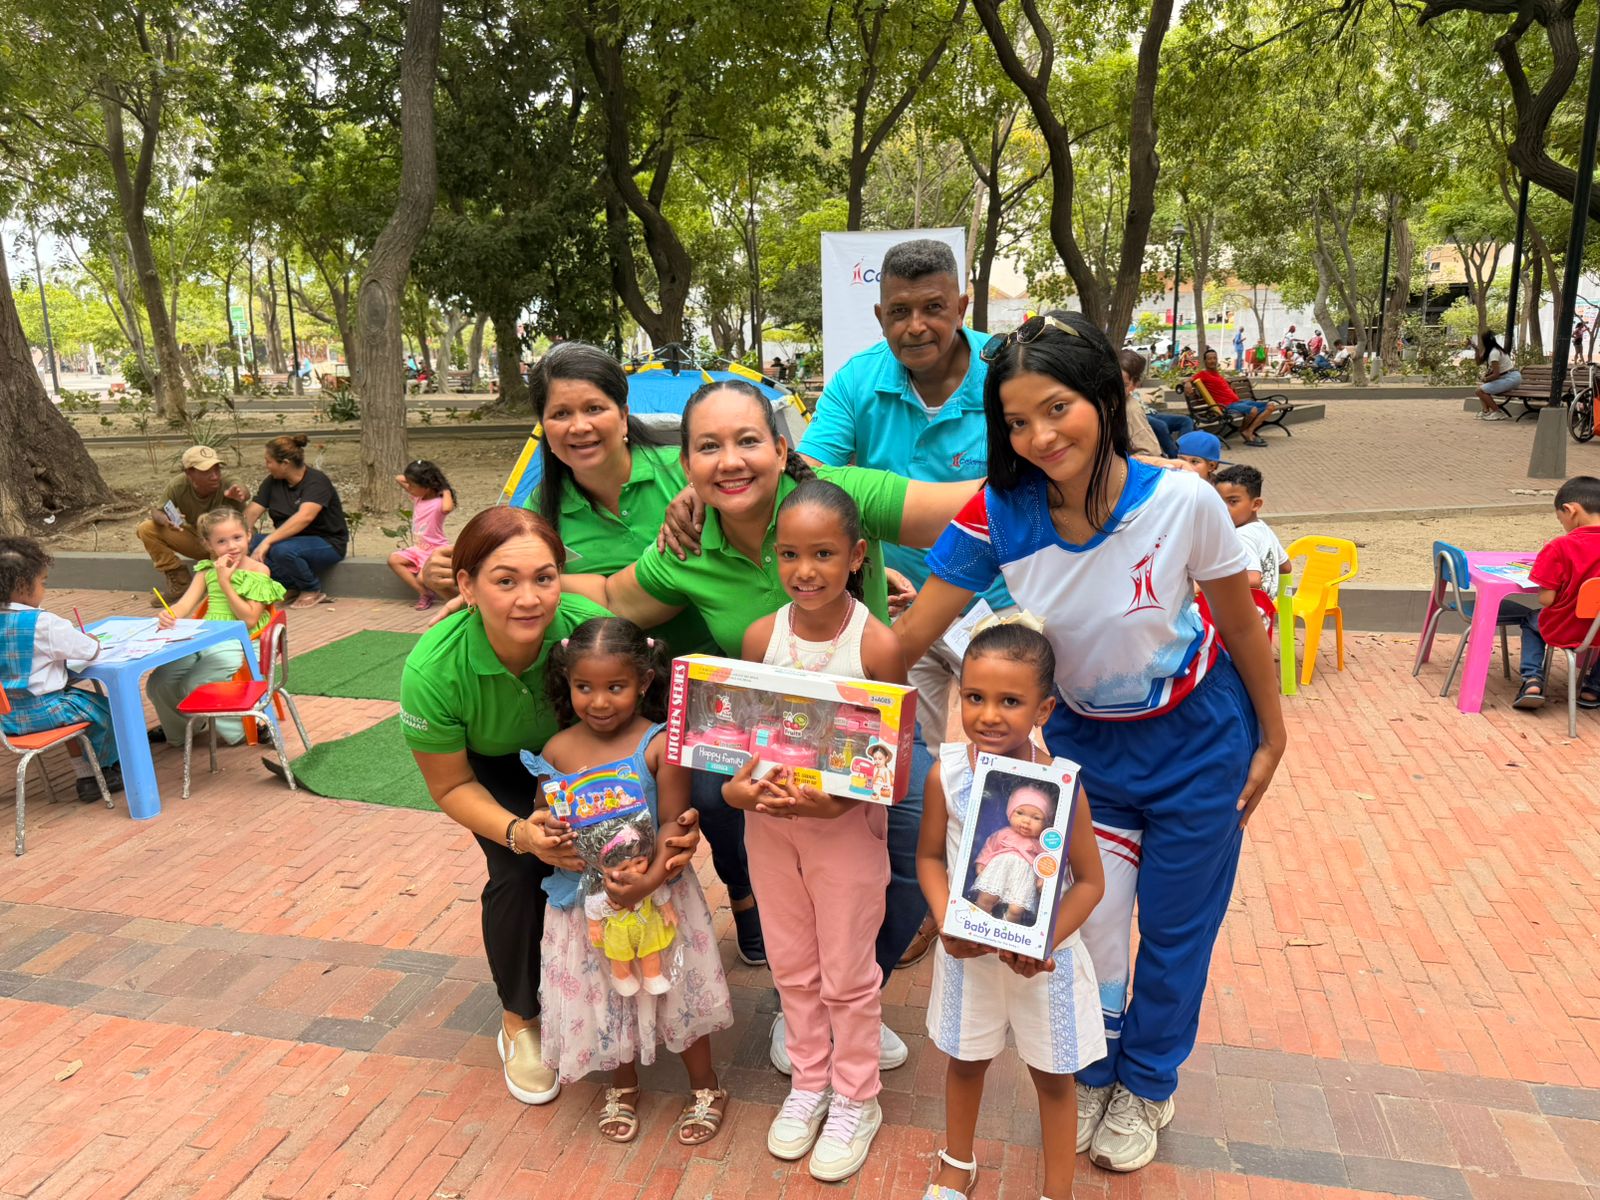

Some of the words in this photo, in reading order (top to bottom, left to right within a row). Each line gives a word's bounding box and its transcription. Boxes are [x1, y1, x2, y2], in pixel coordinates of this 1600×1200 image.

[672, 664, 686, 705] SERIES
[668, 709, 682, 760] KITCHEN
[699, 747, 721, 763] Happy
[963, 920, 991, 937] Baby
[993, 928, 1032, 946] Babble
